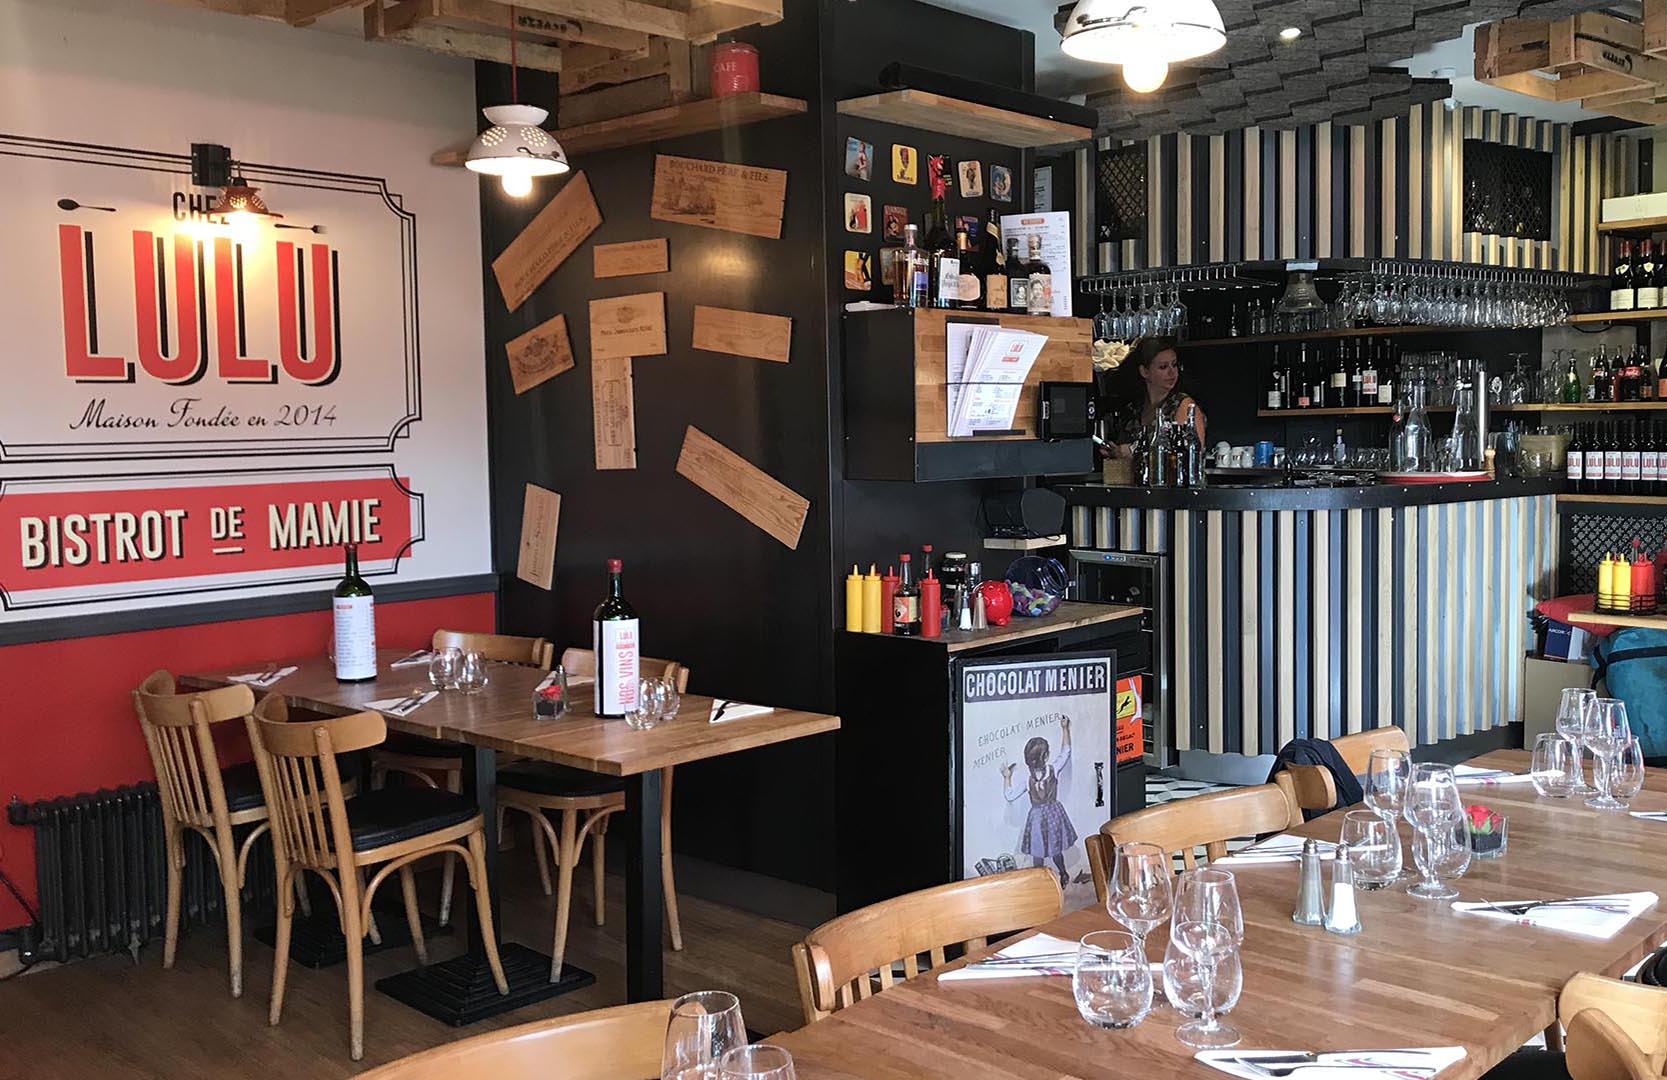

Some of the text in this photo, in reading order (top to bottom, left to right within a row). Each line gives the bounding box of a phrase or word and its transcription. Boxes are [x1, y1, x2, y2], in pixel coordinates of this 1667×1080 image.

[172, 191, 230, 224] CHE
[58, 223, 342, 387] LULU
[69, 397, 338, 430] Maison Fondée en 2014
[20, 498, 383, 570] BISTROT DE MAMIE
[619, 651, 633, 678] VINS
[966, 665, 1105, 698] CHOCOLAT MENIER
[977, 712, 1062, 748] CHOCOLAT MENIER
[972, 747, 1006, 769] MENIER
